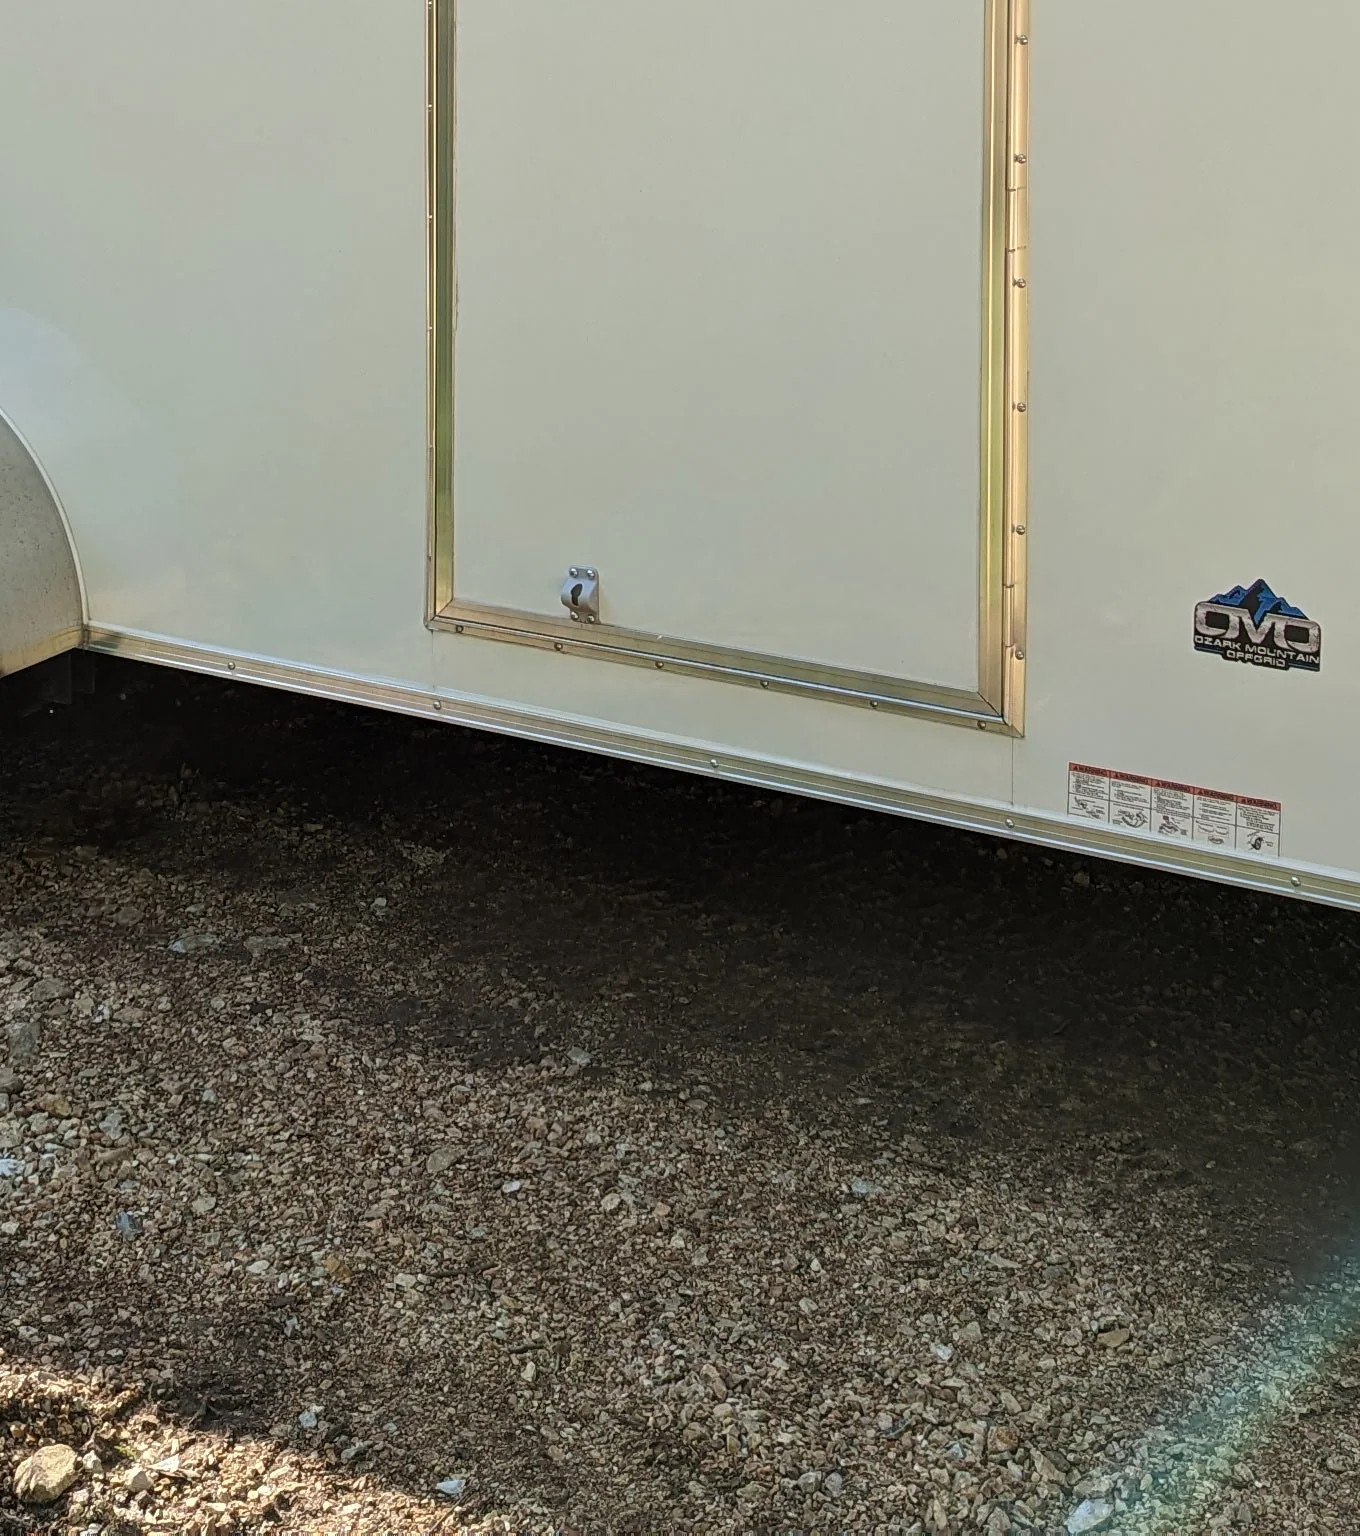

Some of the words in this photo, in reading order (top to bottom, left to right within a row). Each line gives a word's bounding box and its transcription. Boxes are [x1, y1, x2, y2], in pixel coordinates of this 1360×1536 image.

[1194, 635, 1241, 650] OZARK
[1245, 644, 1320, 664] MOUNTAIN
[1226, 650, 1286, 667] OFFGRID
